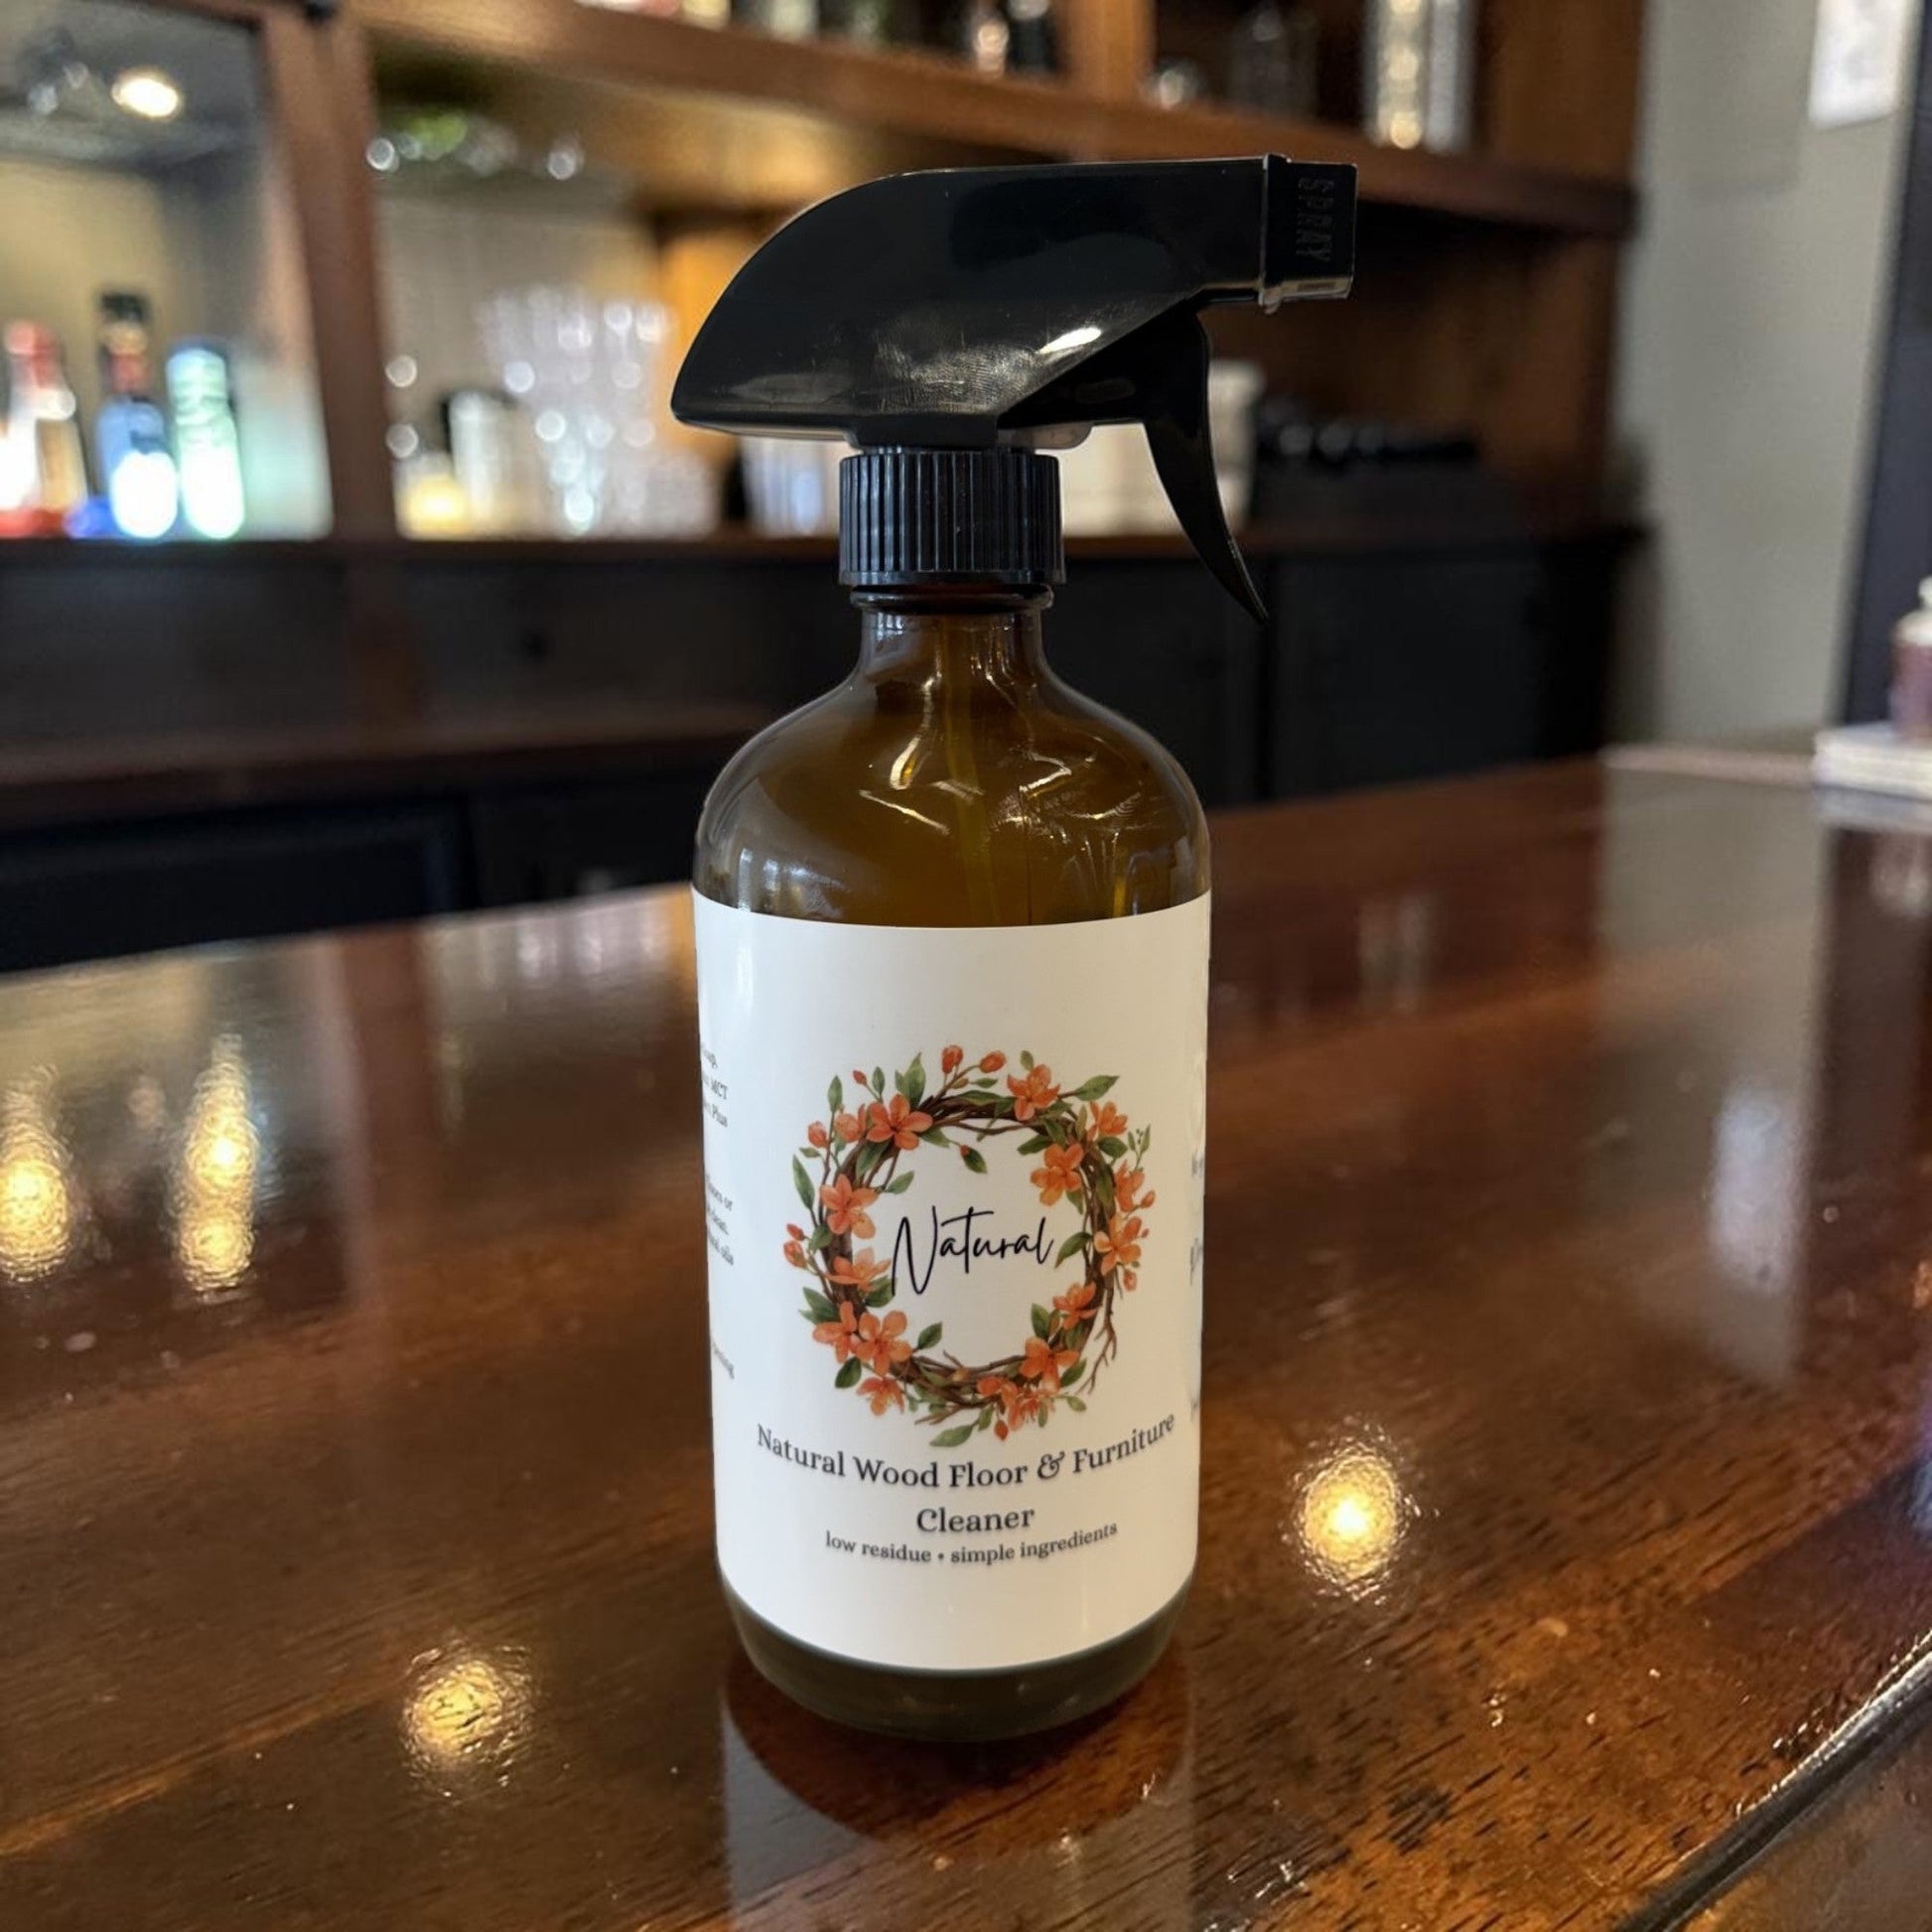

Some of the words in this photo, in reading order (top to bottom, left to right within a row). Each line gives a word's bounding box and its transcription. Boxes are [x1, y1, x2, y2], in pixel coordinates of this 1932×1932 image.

[1296, 177, 1335, 262] SPRAY
[891, 1204, 1054, 1296] Natural
[757, 1423, 846, 1477] Natural
[853, 1455, 940, 1488] Wood
[949, 1460, 1029, 1488] Floor
[1036, 1450, 1066, 1480] &
[1072, 1413, 1175, 1474] Furniture
[825, 1530, 857, 1553] low
[862, 1544, 931, 1563] residue
[950, 1544, 1016, 1566] simple
[1020, 1522, 1118, 1559] ingredients
[916, 1506, 1035, 1533] Cleaner
